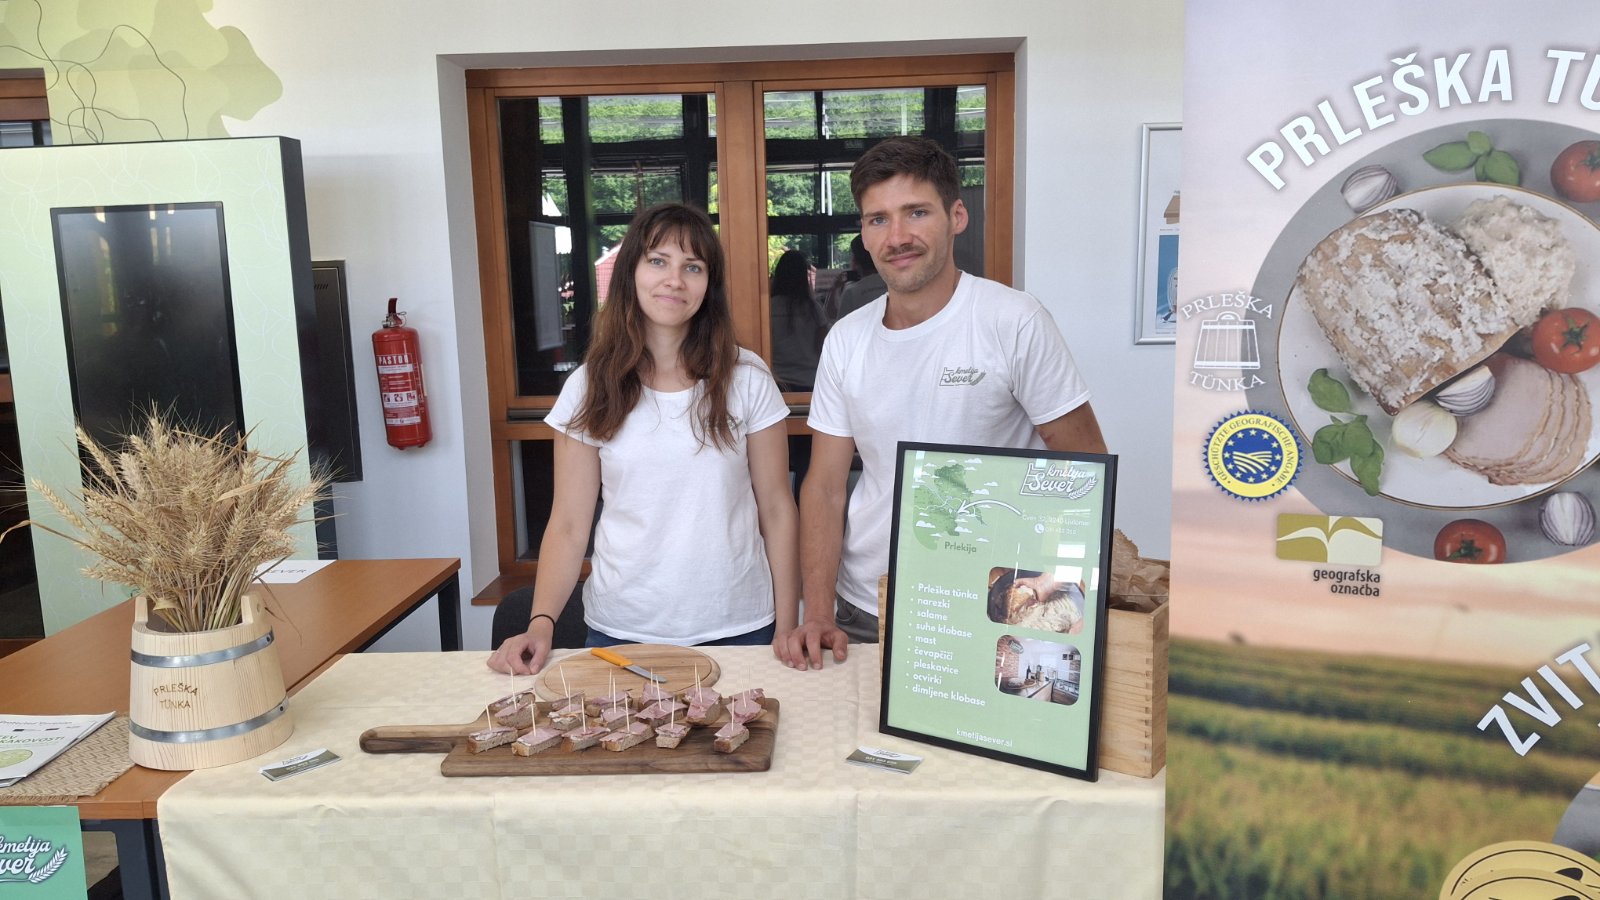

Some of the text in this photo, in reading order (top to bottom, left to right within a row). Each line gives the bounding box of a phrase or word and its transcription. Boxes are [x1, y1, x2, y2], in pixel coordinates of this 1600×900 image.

[1246, 49, 1513, 191] PRLEŠKA
[1181, 290, 1273, 320] PRLEŠKA
[1190, 371, 1267, 391] TÜNKA
[1211, 417, 1295, 484] GESCHÜTZTE GEOGRAFISCHE ANGABE
[1028, 472, 1074, 493] Sever
[944, 541, 977, 554] Prlekija
[1313, 569, 1381, 583] geografska
[918, 583, 951, 597] Prleška
[1330, 584, 1380, 597] označba
[917, 598, 950, 609] narezki
[916, 610, 948, 621] salame
[915, 622, 973, 638] suhe klobase
[915, 635, 937, 645] mast
[913, 659, 959, 675] pleskavice
[912, 672, 942, 685] ocvirki
[153, 682, 198, 697] PRLEŠKA
[912, 684, 986, 706] dimljene klobase
